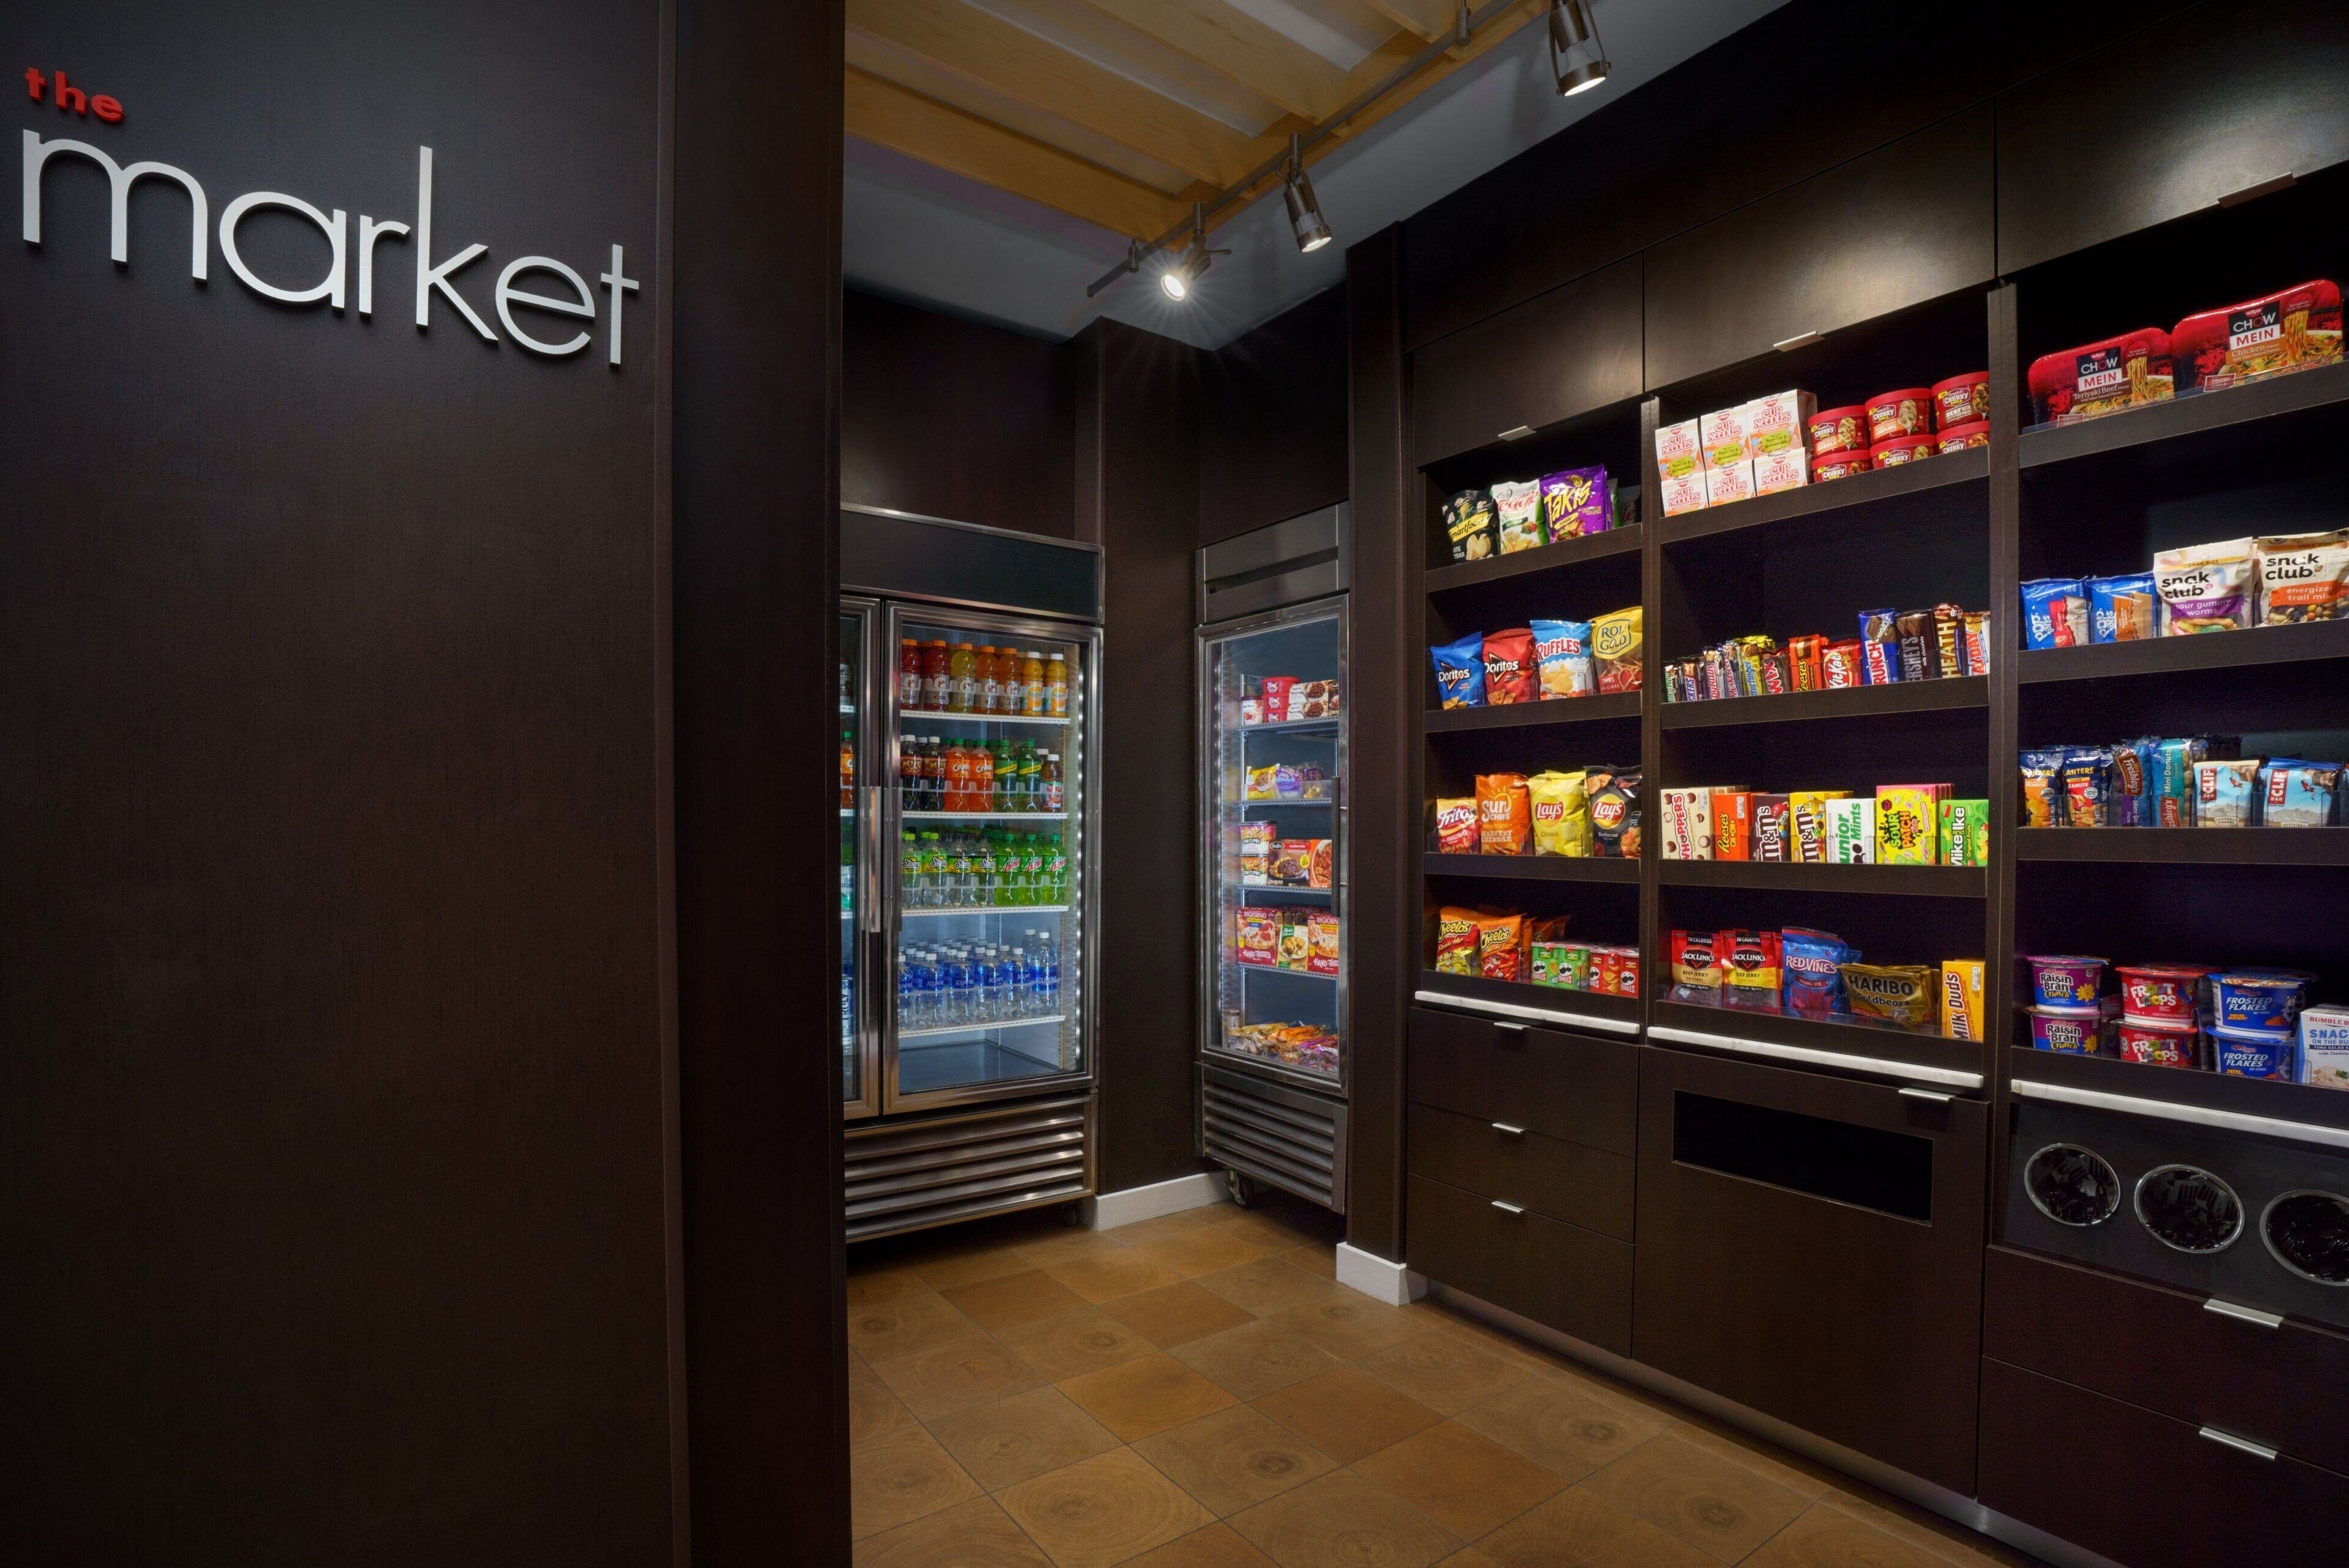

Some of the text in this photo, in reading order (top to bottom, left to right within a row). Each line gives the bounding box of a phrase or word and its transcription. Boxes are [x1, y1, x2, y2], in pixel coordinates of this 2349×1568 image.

[25, 67, 124, 122] the
[23, 129, 640, 367] market
[2233, 312, 2276, 333] CHOW
[2236, 328, 2274, 347] MEIN
[2232, 344, 2265, 358] Chicken
[2080, 357, 2118, 374] CHOW
[2084, 372, 2117, 388] MEIN
[1945, 392, 1969, 405] CHUNKY
[2073, 389, 2101, 401] Teriyaki
[2101, 384, 2118, 393] Beef
[1754, 411, 1792, 429] NOODLES
[1762, 406, 1783, 418] CUP
[1708, 425, 1742, 442] NOODLES
[1715, 420, 1734, 431] CUP
[1662, 439, 1693, 455] NOODLES
[1669, 434, 1686, 445] CUP
[1762, 470, 1800, 485] NOODLES
[1769, 464, 1791, 475] CUP
[1713, 481, 1748, 497] NOODLES
[1720, 475, 1740, 487] CUP
[1668, 492, 1701, 507] NOODLES
[1675, 487, 1693, 497] CUP
[2162, 571, 2210, 588] snak
[2265, 566, 2313, 580] club
[2164, 585, 2205, 599] club
[2197, 599, 2232, 609] gummy
[1536, 638, 1581, 662] RUFFLES
[1600, 635, 1627, 650] GOLD
[1937, 621, 1962, 678] HEATH
[1901, 637, 1923, 681] ERSHEY'S
[1966, 632, 1987, 676] AYDAY
[1484, 660, 1519, 674] Doritos
[1868, 642, 1887, 685] RUNCH
[1438, 668, 1470, 682] Doritos
[1764, 660, 1784, 693] WIX
[2164, 749, 2172, 775] Donuts
[2064, 767, 2094, 776] LANTERS
[2123, 758, 2140, 794] Freshley's
[2203, 768, 2214, 793] CLIF
[2271, 772, 2287, 797] CLIF
[1438, 807, 1475, 829] Fritos
[1482, 800, 1512, 823] Sun
[1537, 802, 1563, 821] Lay's
[1593, 802, 1622, 821] Lay's
[1672, 794, 1693, 860] WHOPPERS
[1836, 803, 1861, 864] unior Mints
[1888, 813, 1901, 848] SOUR
[1899, 811, 1915, 848] PATCH
[1439, 921, 1471, 942] Cheetos
[1480, 927, 1510, 950] Cheetos
[1313, 958, 1339, 967] HAND-TOSS
[1786, 955, 1837, 974] RED VINES
[1847, 975, 1913, 996] HARIBO
[2040, 973, 2073, 985] Raisin
[2044, 982, 2071, 992] Bran
[1945, 972, 1965, 1010] Duds
[2044, 990, 2070, 999] Crunch
[2131, 983, 2175, 999] FROOT
[1857, 992, 1911, 1007] Goldbears
[2135, 994, 2177, 1008] LOOPS
[2309, 1016, 2342, 1025] BUMBLE
[2046, 1024, 2082, 1037] Raisin
[2050, 1033, 2079, 1044] Bran
[2309, 1029, 2349, 1038] SNAC
[2050, 1041, 2077, 1050] Crunch
[2131, 1038, 2178, 1053] FROOT
[2137, 1050, 2178, 1062] LOOPS
